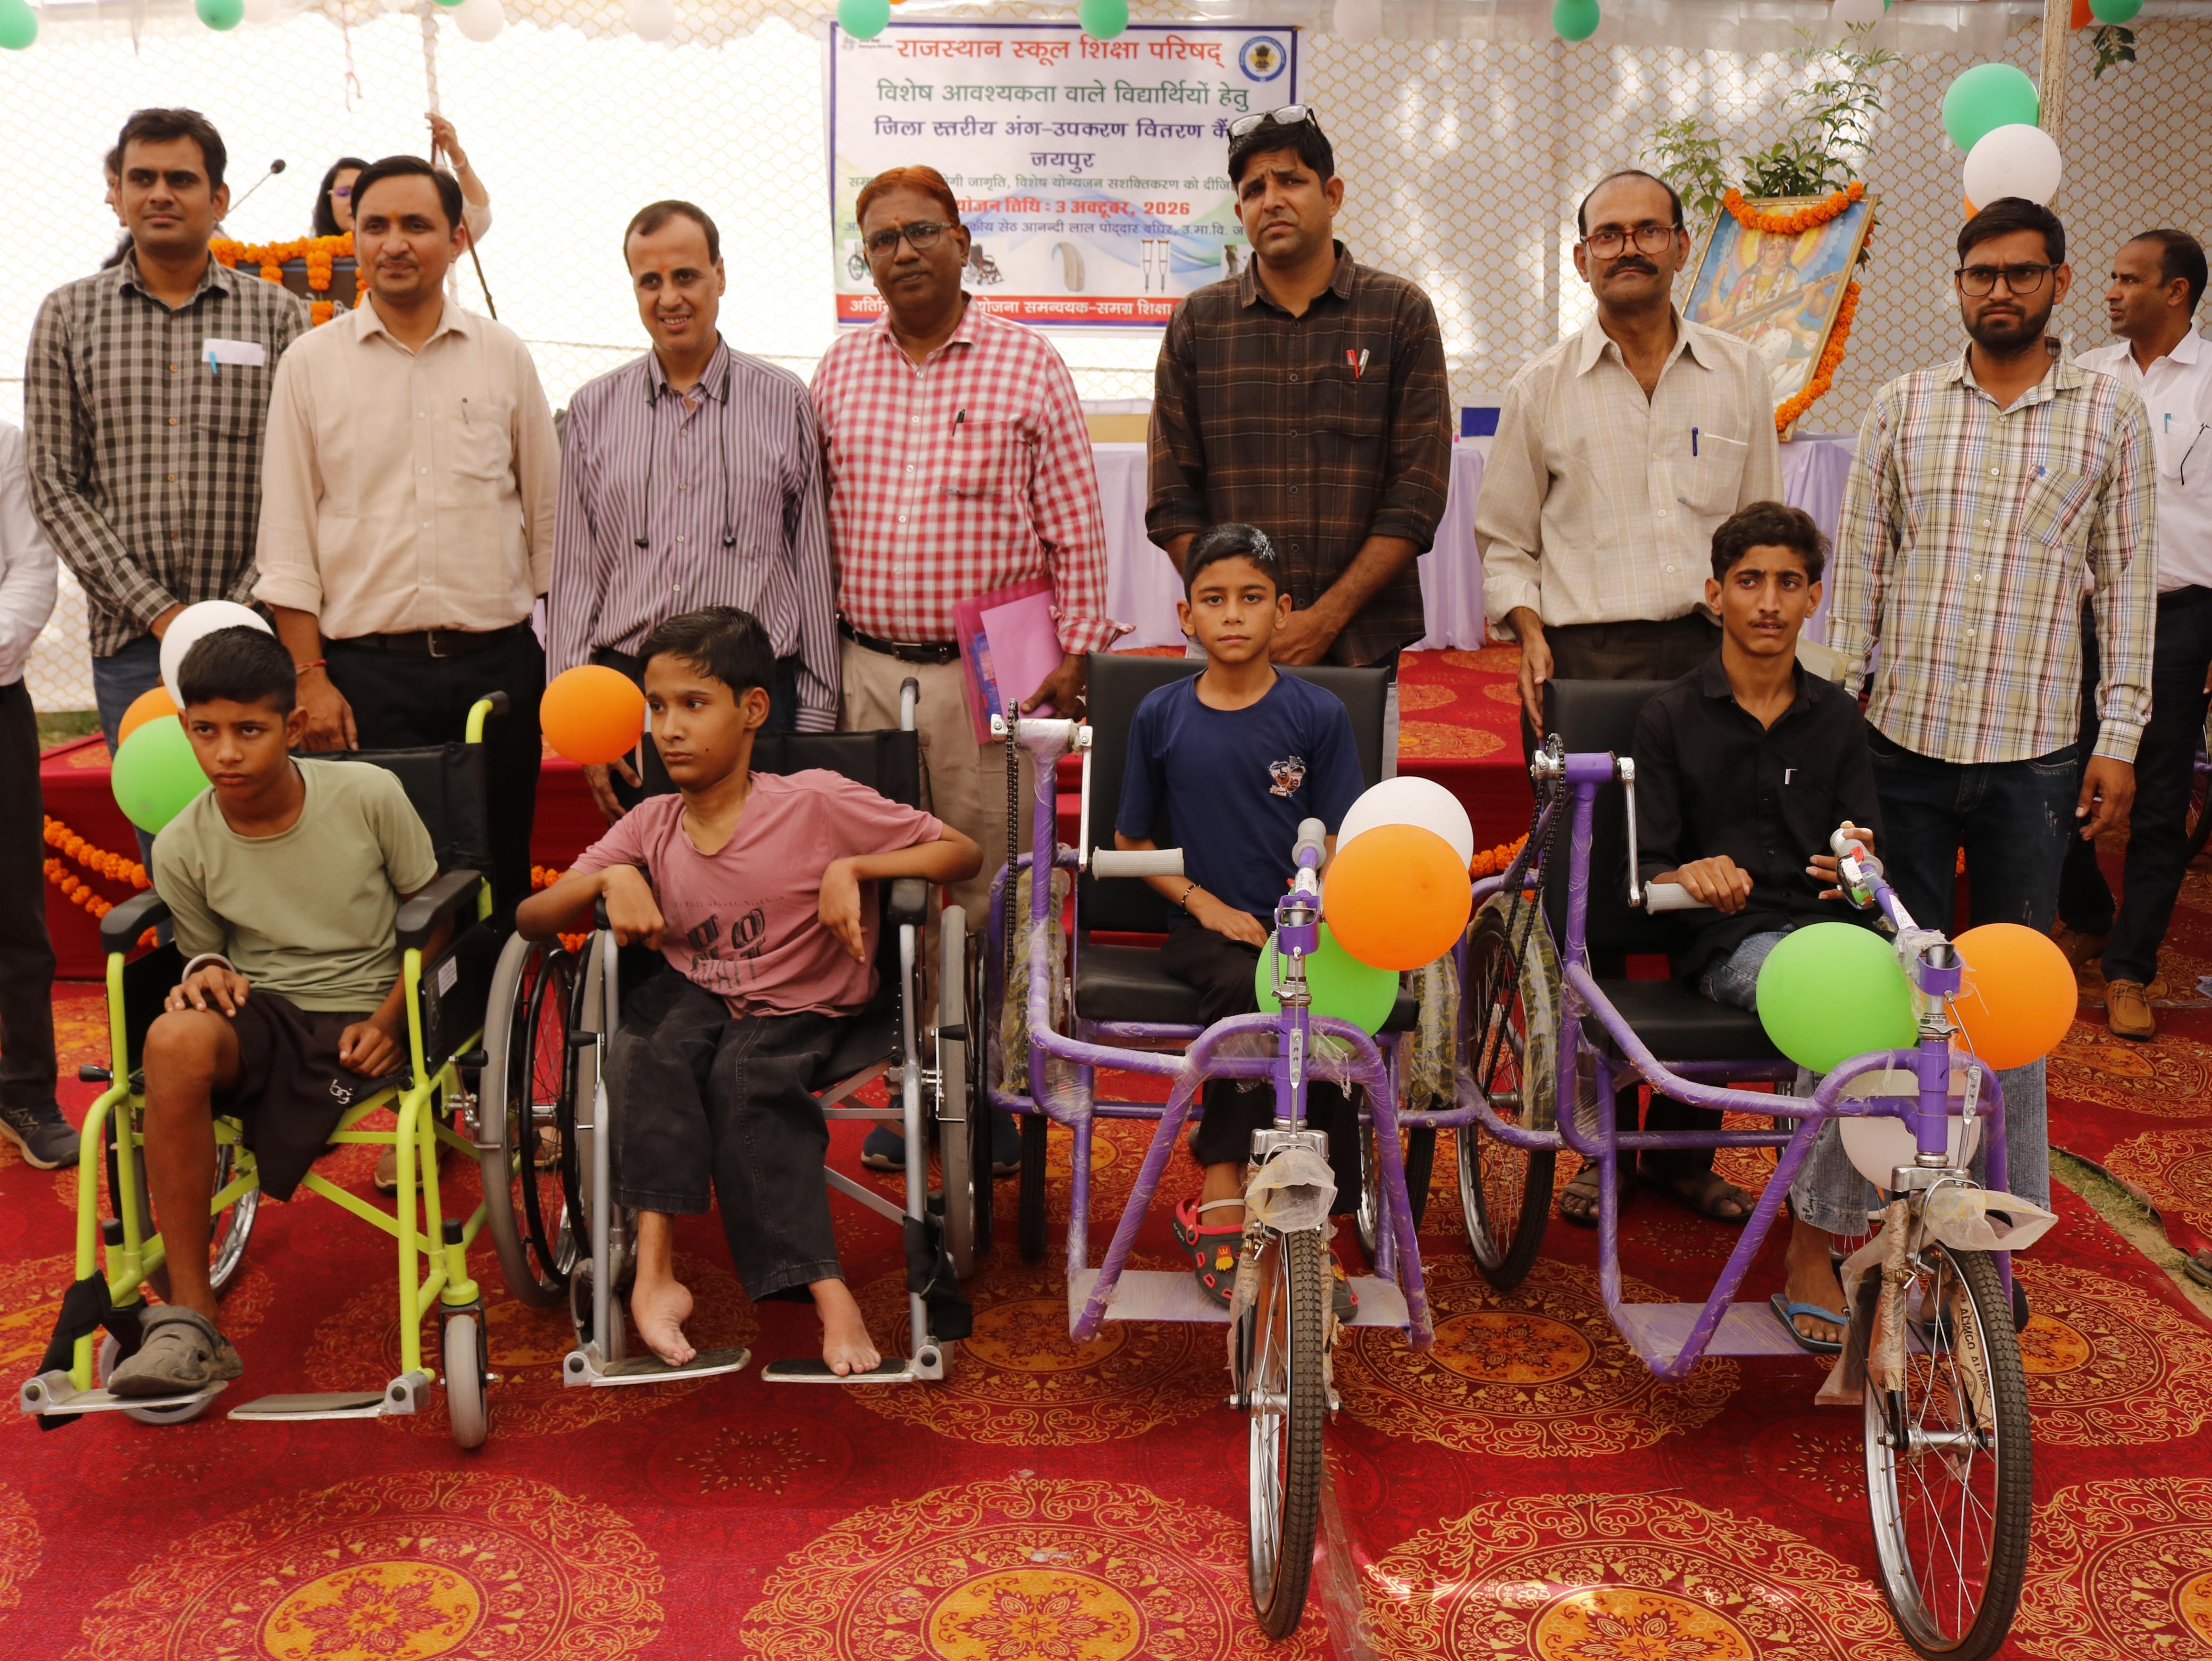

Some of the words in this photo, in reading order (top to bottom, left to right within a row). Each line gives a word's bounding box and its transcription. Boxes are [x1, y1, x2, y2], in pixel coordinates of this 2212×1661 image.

[896, 40, 1002, 59] राजस्थान
[1011, 40, 1070, 66] स्कूल
[1079, 34, 1139, 60] शिक्षा
[1148, 34, 1225, 68] परिषद्
[877, 78, 934, 102] विशेष
[942, 85, 1057, 102] आवश्यकता
[1065, 79, 1105, 103] वाले
[1115, 79, 1210, 104] विद्यार्थियों
[1218, 81, 1250, 112] हेतु
[875, 115, 925, 136] जिला
[933, 115, 998, 137] स्तरीय
[1137, 118, 1205, 139] वितरण
[1212, 119, 1229, 139] कैं
[1030, 152, 1095, 174] जयपुर
[1016, 173, 1047, 188] विशेष
[1183, 176, 1199, 189] को
[1203, 176, 1235, 190] दीजि
[957, 196, 1001, 213] योजन
[1004, 196, 1041, 213] तिथि
[1055, 201, 1066, 213] 3
[1144, 202, 1191, 215] 2026
[999, 219, 1018, 232] सेठ
[1069, 223, 1094, 234] लाल
[850, 296, 889, 313] अतिरि
[977, 296, 1019, 313] योजना
[1137, 298, 1172, 315] शिक्षा
